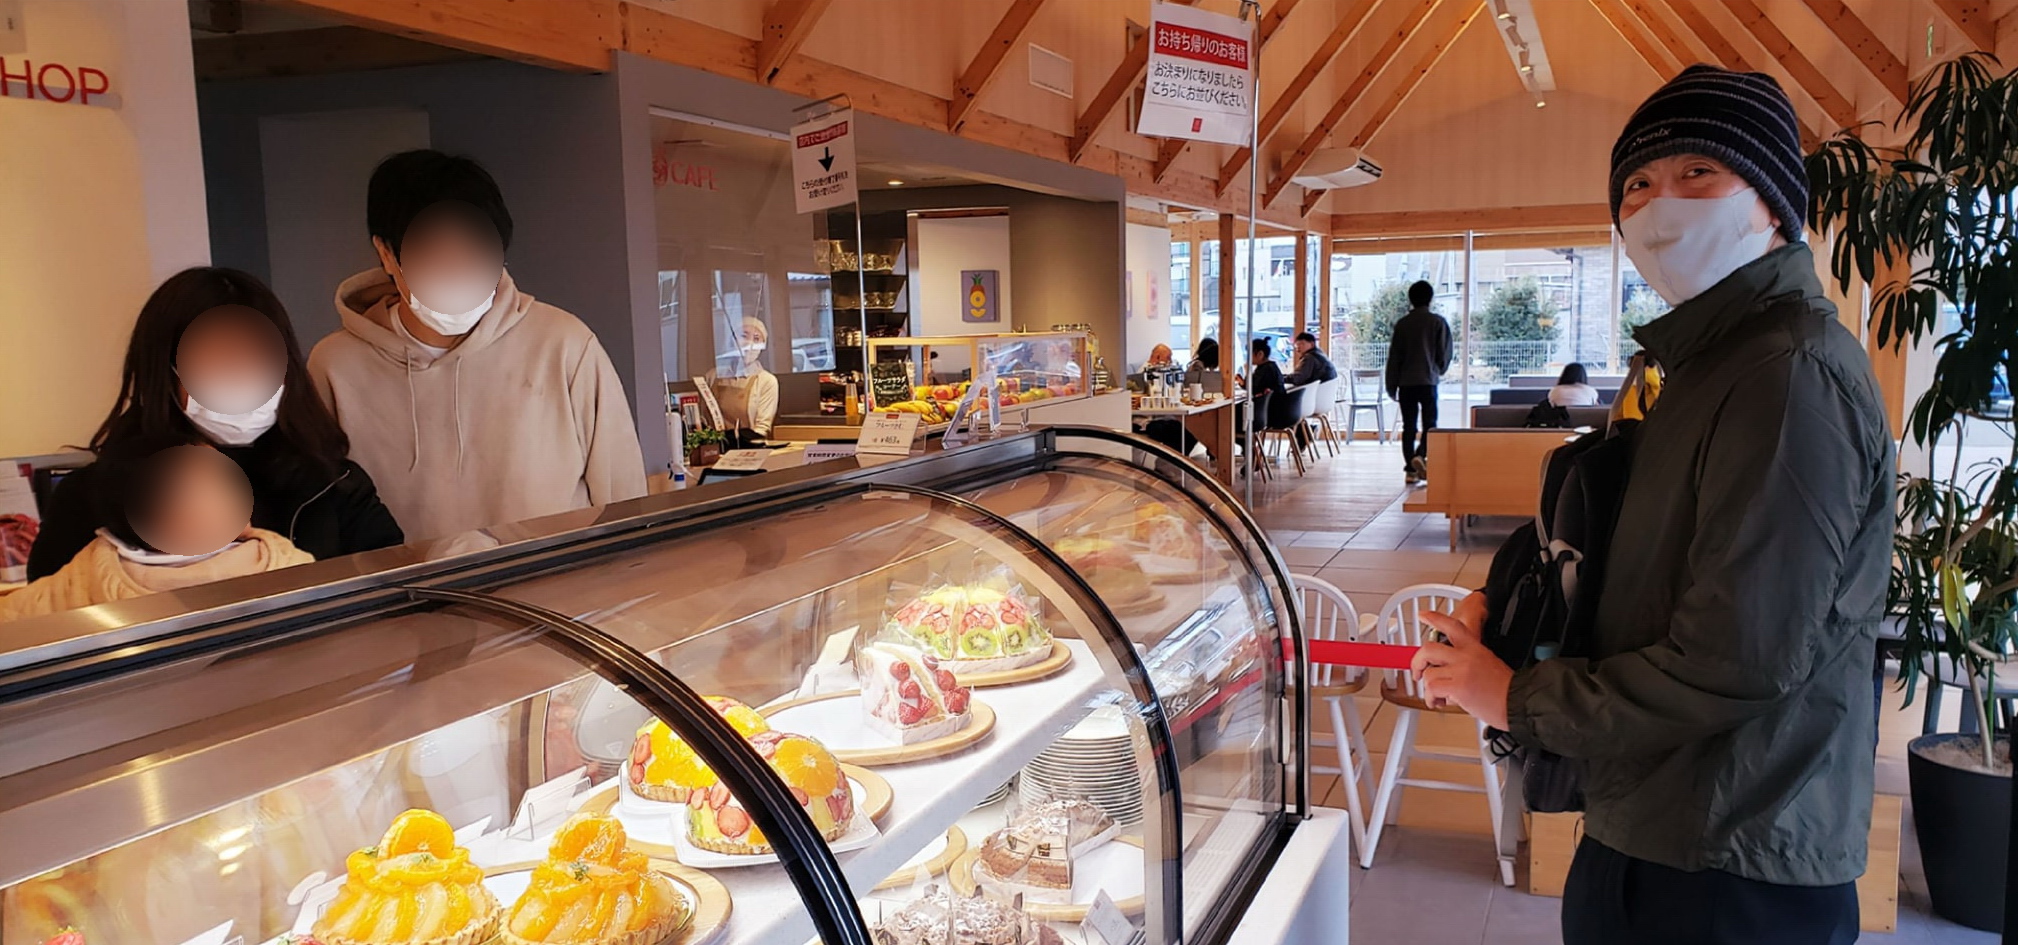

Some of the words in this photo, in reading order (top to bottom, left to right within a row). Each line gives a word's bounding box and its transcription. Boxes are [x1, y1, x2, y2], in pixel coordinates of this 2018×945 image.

[1157, 28, 1247, 63] お持ち帰りのお客様
[0, 56, 109, 105] HOP
[1154, 61, 1244, 90] お決まりになりましたら
